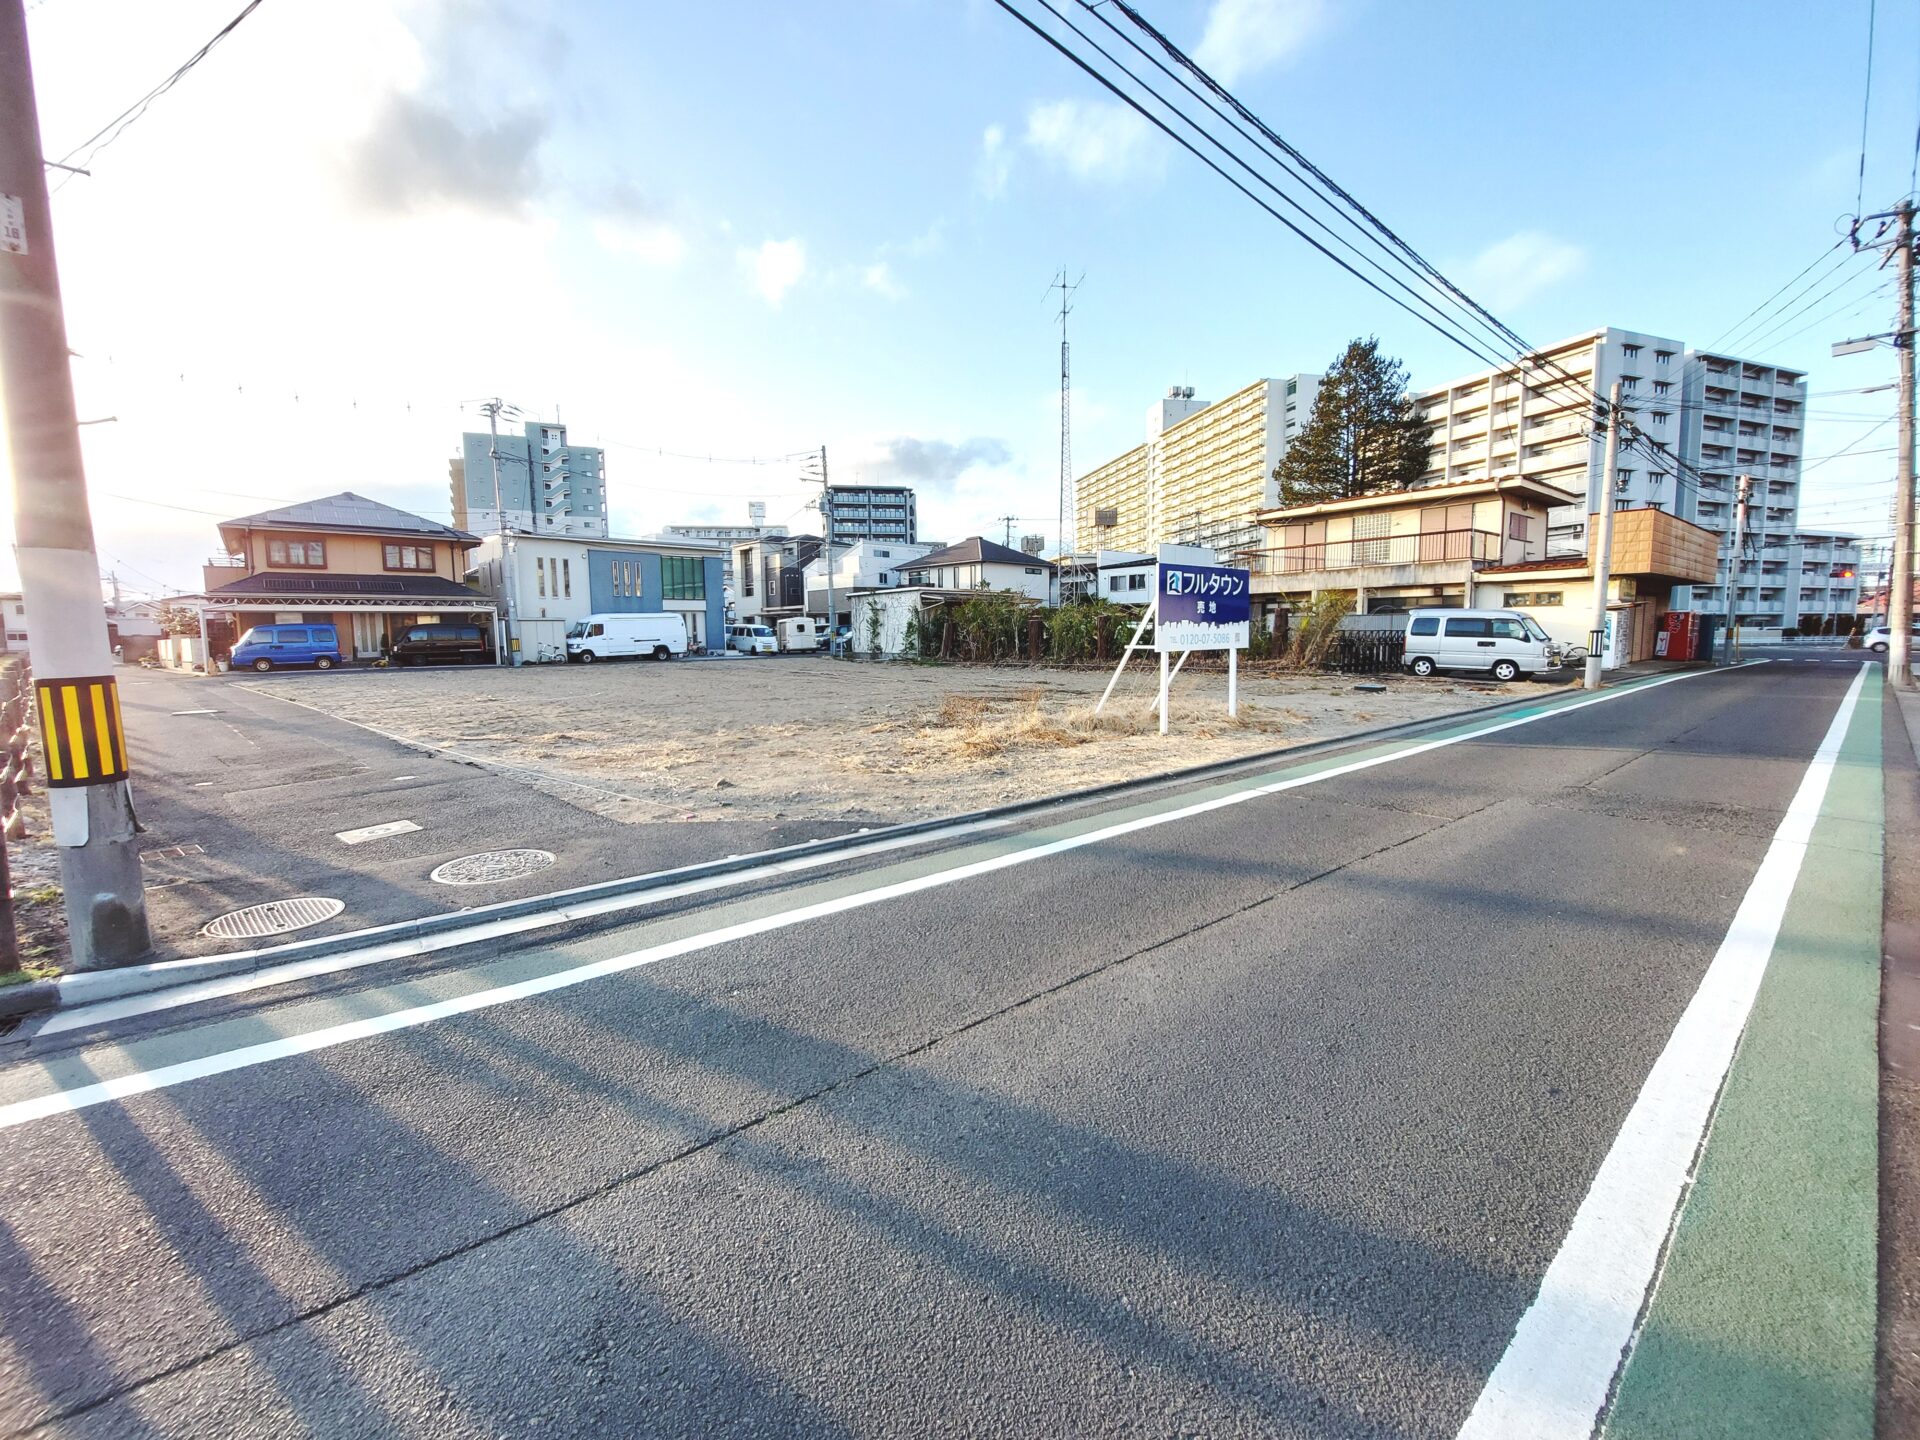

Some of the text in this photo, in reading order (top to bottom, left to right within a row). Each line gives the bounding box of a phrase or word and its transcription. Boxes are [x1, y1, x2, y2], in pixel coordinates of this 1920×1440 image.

[1183, 572, 1244, 596] フルタウン
